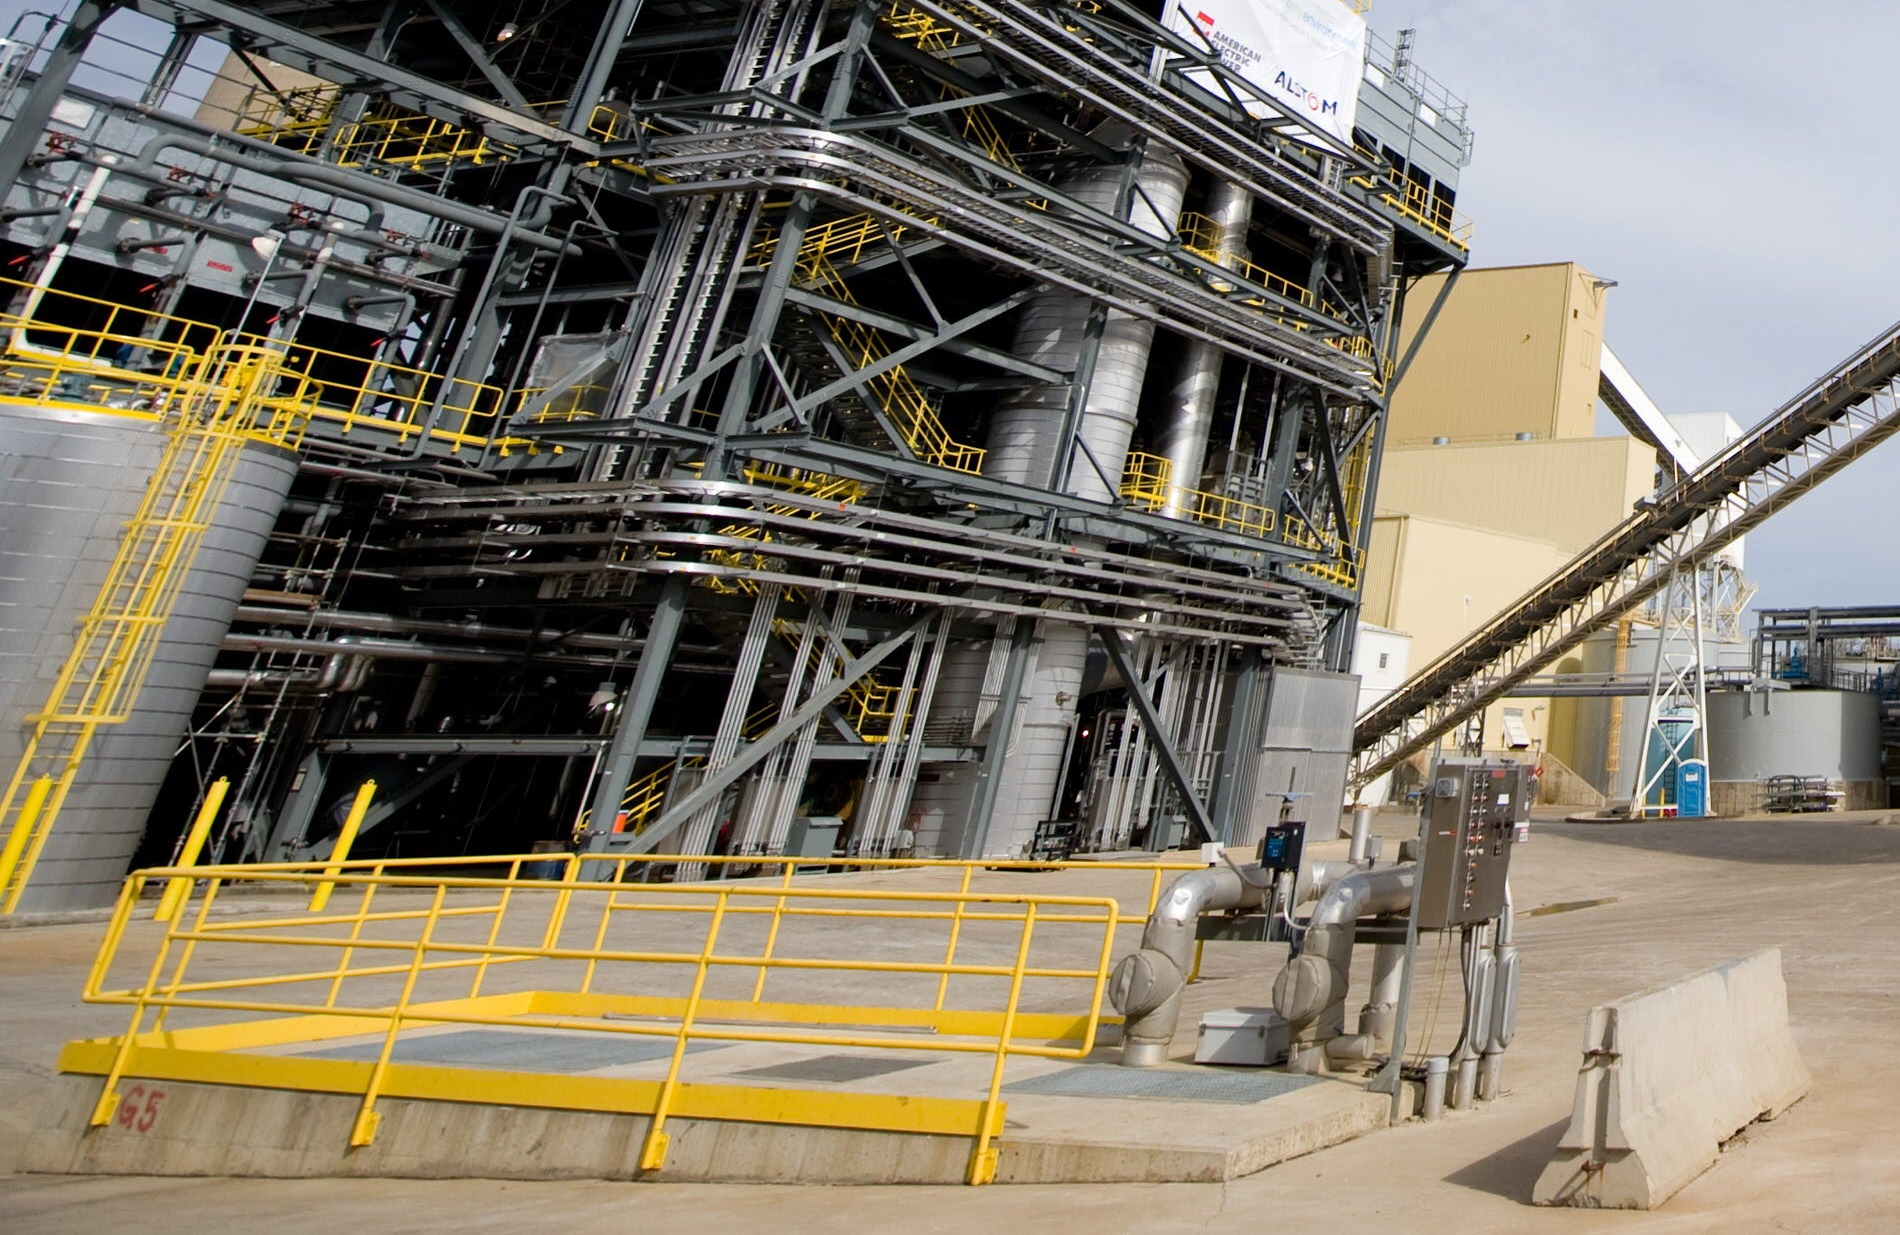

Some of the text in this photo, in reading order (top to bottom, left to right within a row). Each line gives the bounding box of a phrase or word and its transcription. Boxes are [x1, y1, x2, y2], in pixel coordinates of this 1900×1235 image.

[1213, 30, 1262, 63] AMERICAN
[1274, 70, 1338, 115] ALSTOM
[118, 1085, 166, 1133] G5
